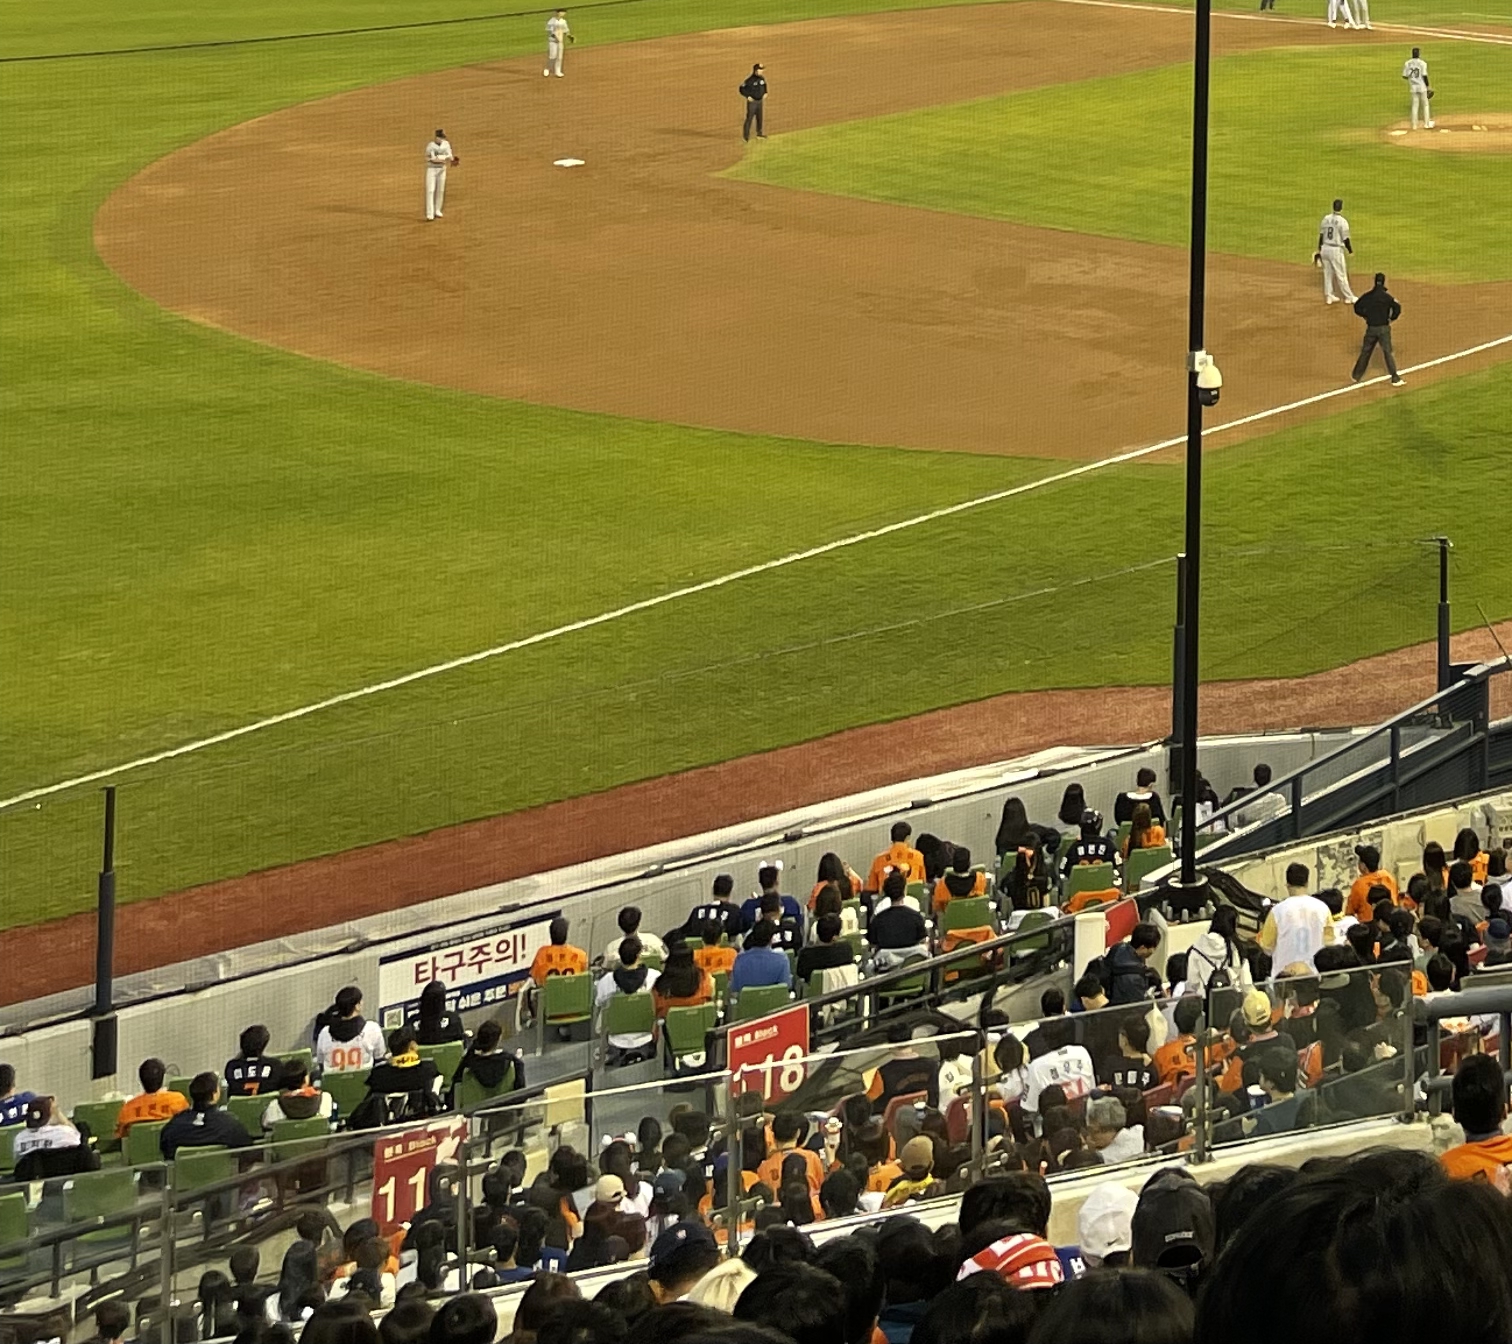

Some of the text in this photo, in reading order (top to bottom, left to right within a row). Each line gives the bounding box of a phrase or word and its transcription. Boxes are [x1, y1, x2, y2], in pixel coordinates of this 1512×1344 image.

[414, 933, 527, 985] 타구주의!
[331, 1047, 362, 1071] 99
[733, 1044, 805, 1101] 118
